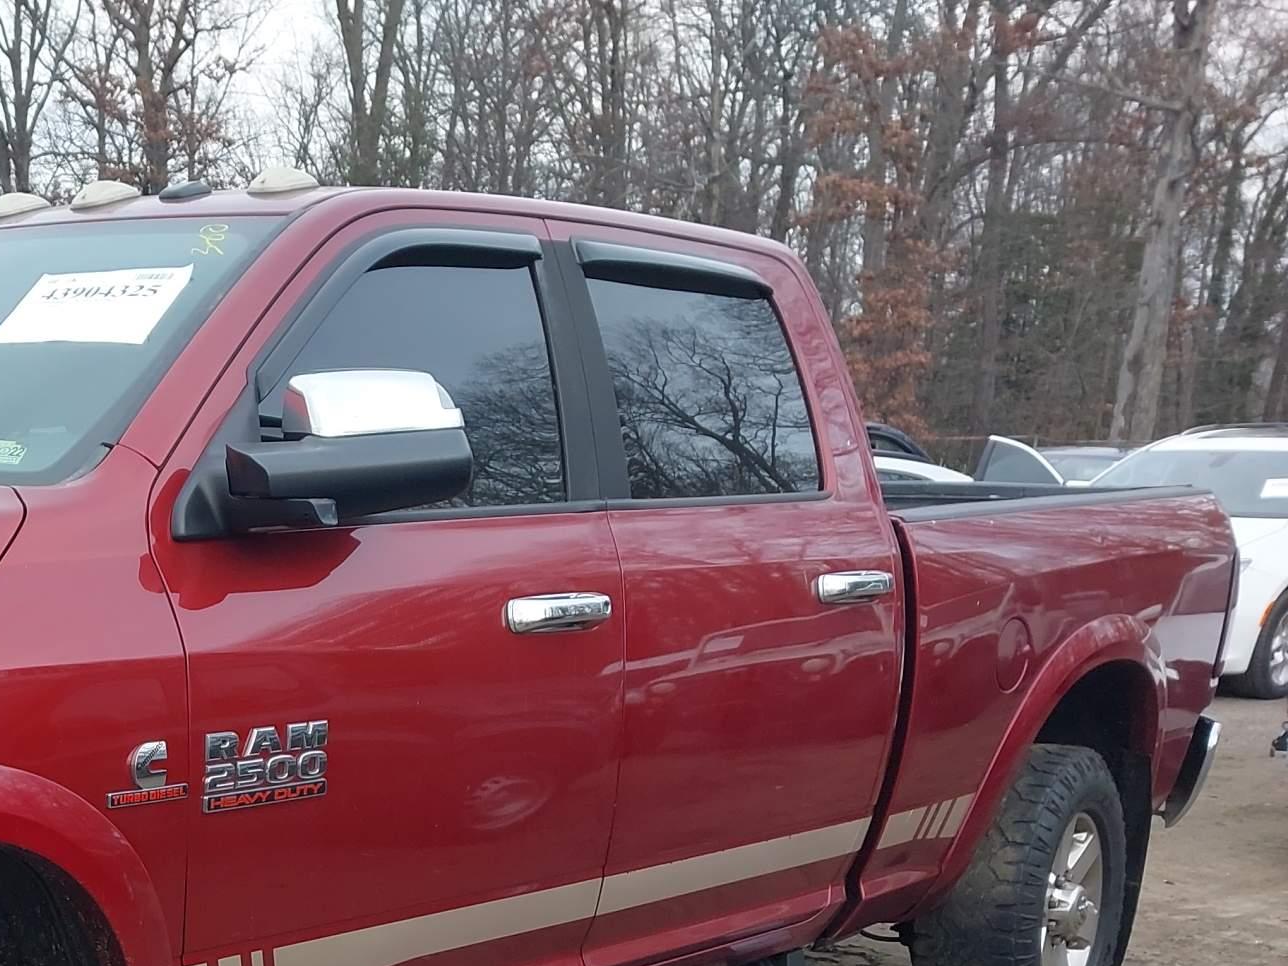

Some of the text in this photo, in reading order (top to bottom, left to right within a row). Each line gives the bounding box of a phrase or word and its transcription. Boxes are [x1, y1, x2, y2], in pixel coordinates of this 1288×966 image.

[41, 284, 162, 301] 43904325
[205, 720, 328, 762] RAM
[203, 750, 327, 793] 2500
[112, 786, 186, 806] TURBO DIESEL
[211, 782, 324, 810] HEAVY DUTY
